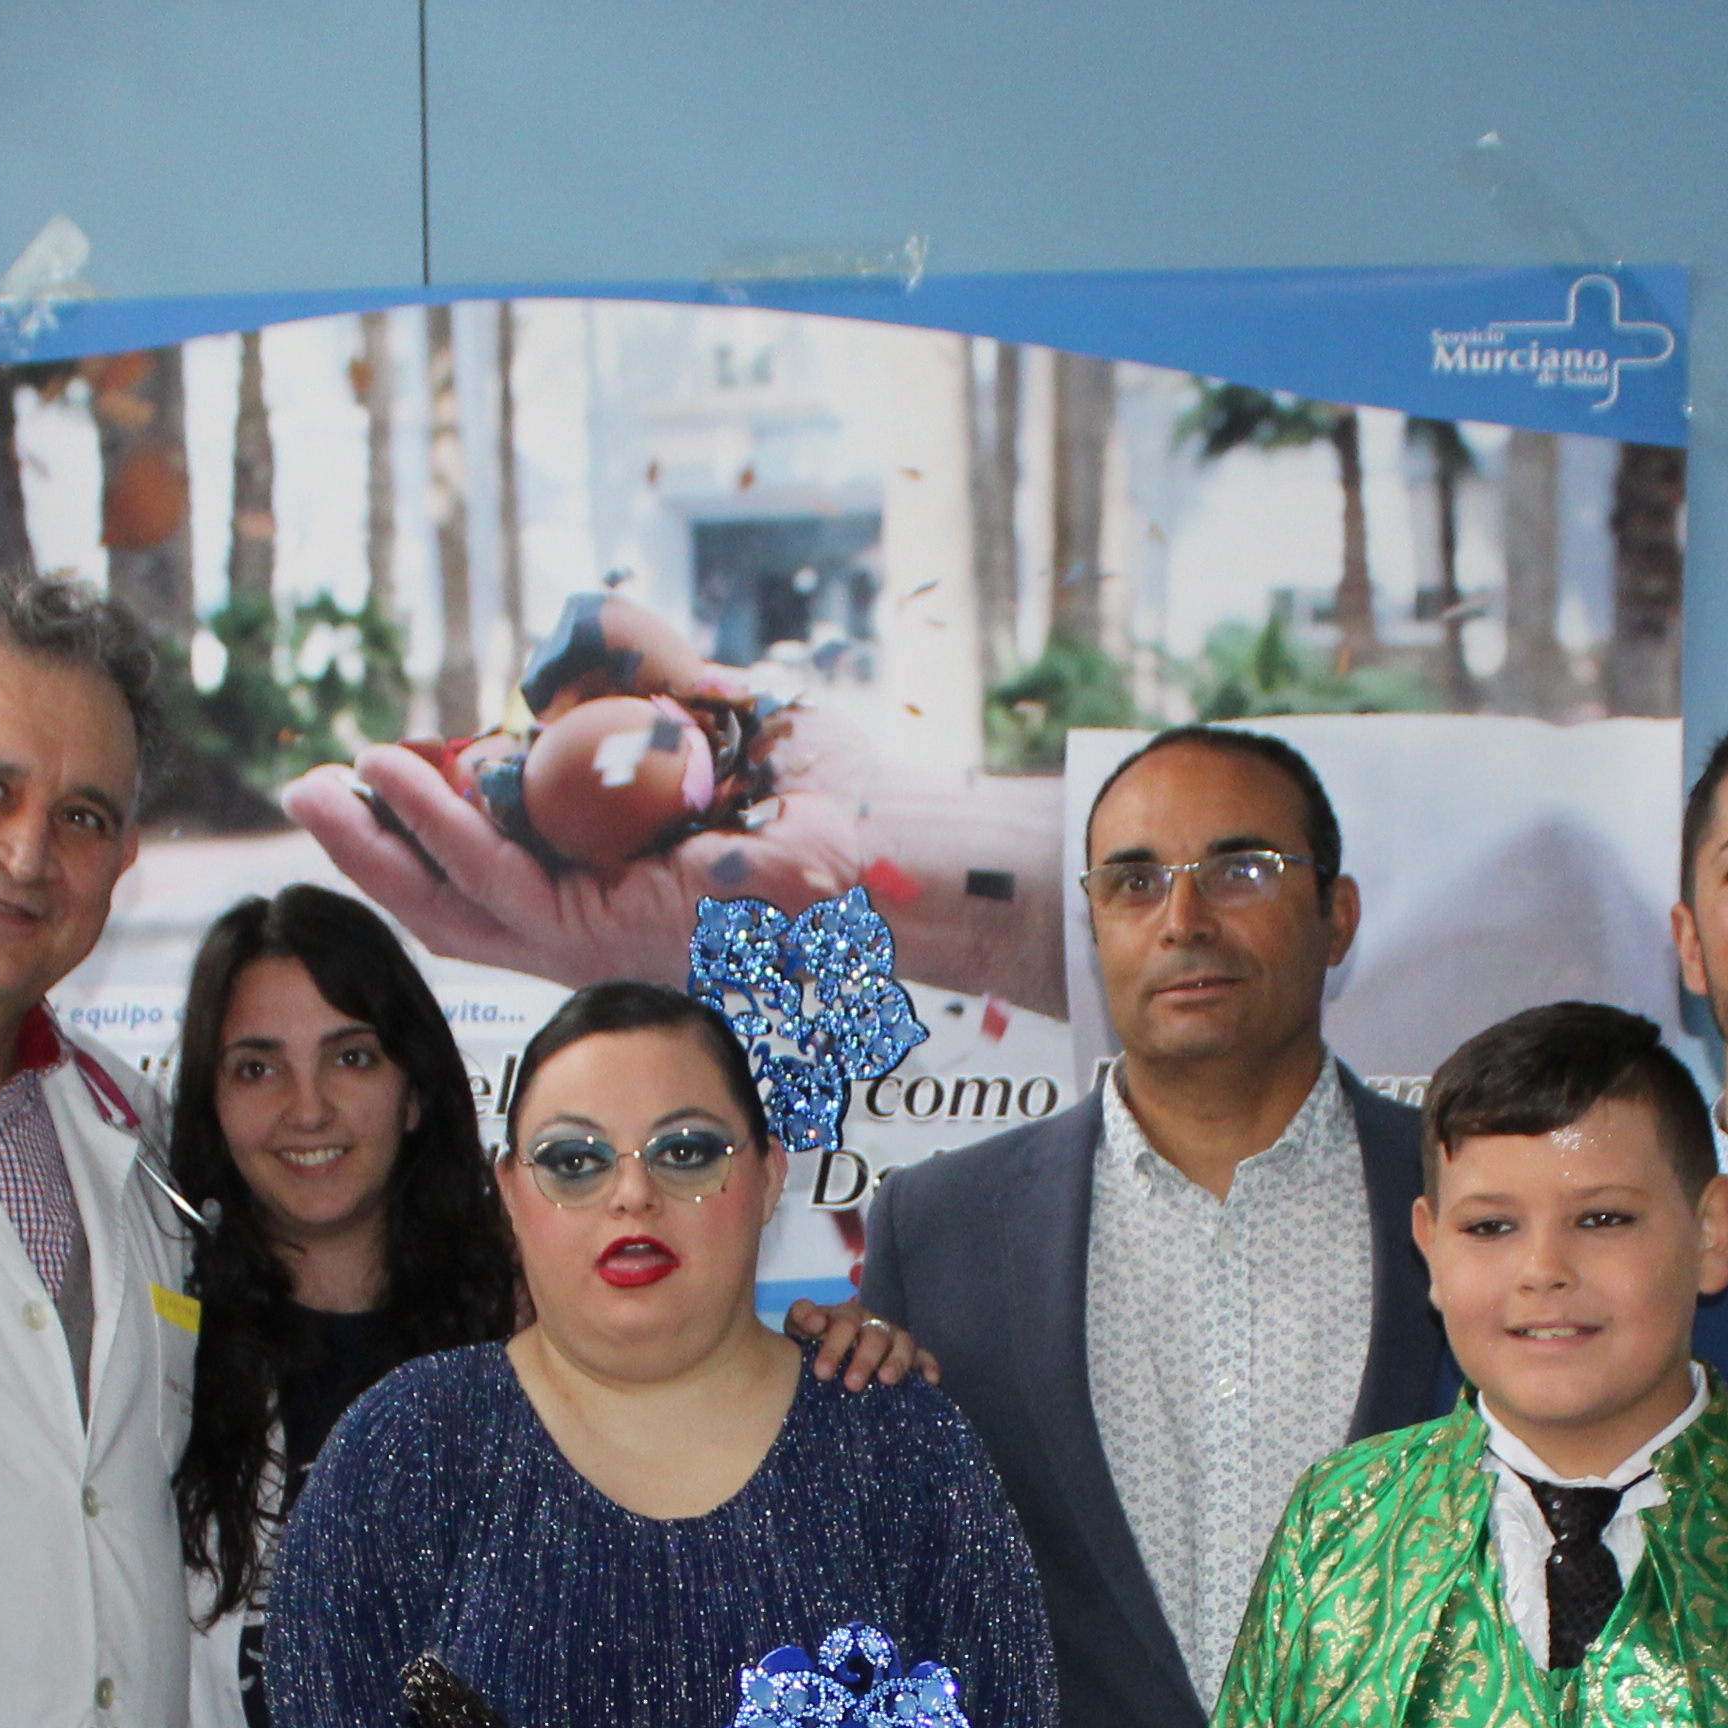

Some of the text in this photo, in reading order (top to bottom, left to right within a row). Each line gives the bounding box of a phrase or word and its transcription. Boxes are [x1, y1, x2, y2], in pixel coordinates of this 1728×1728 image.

[1433, 340, 1609, 370] Murciano
[69, 1004, 163, 1030] equipo
[865, 1074, 1060, 1119] como
